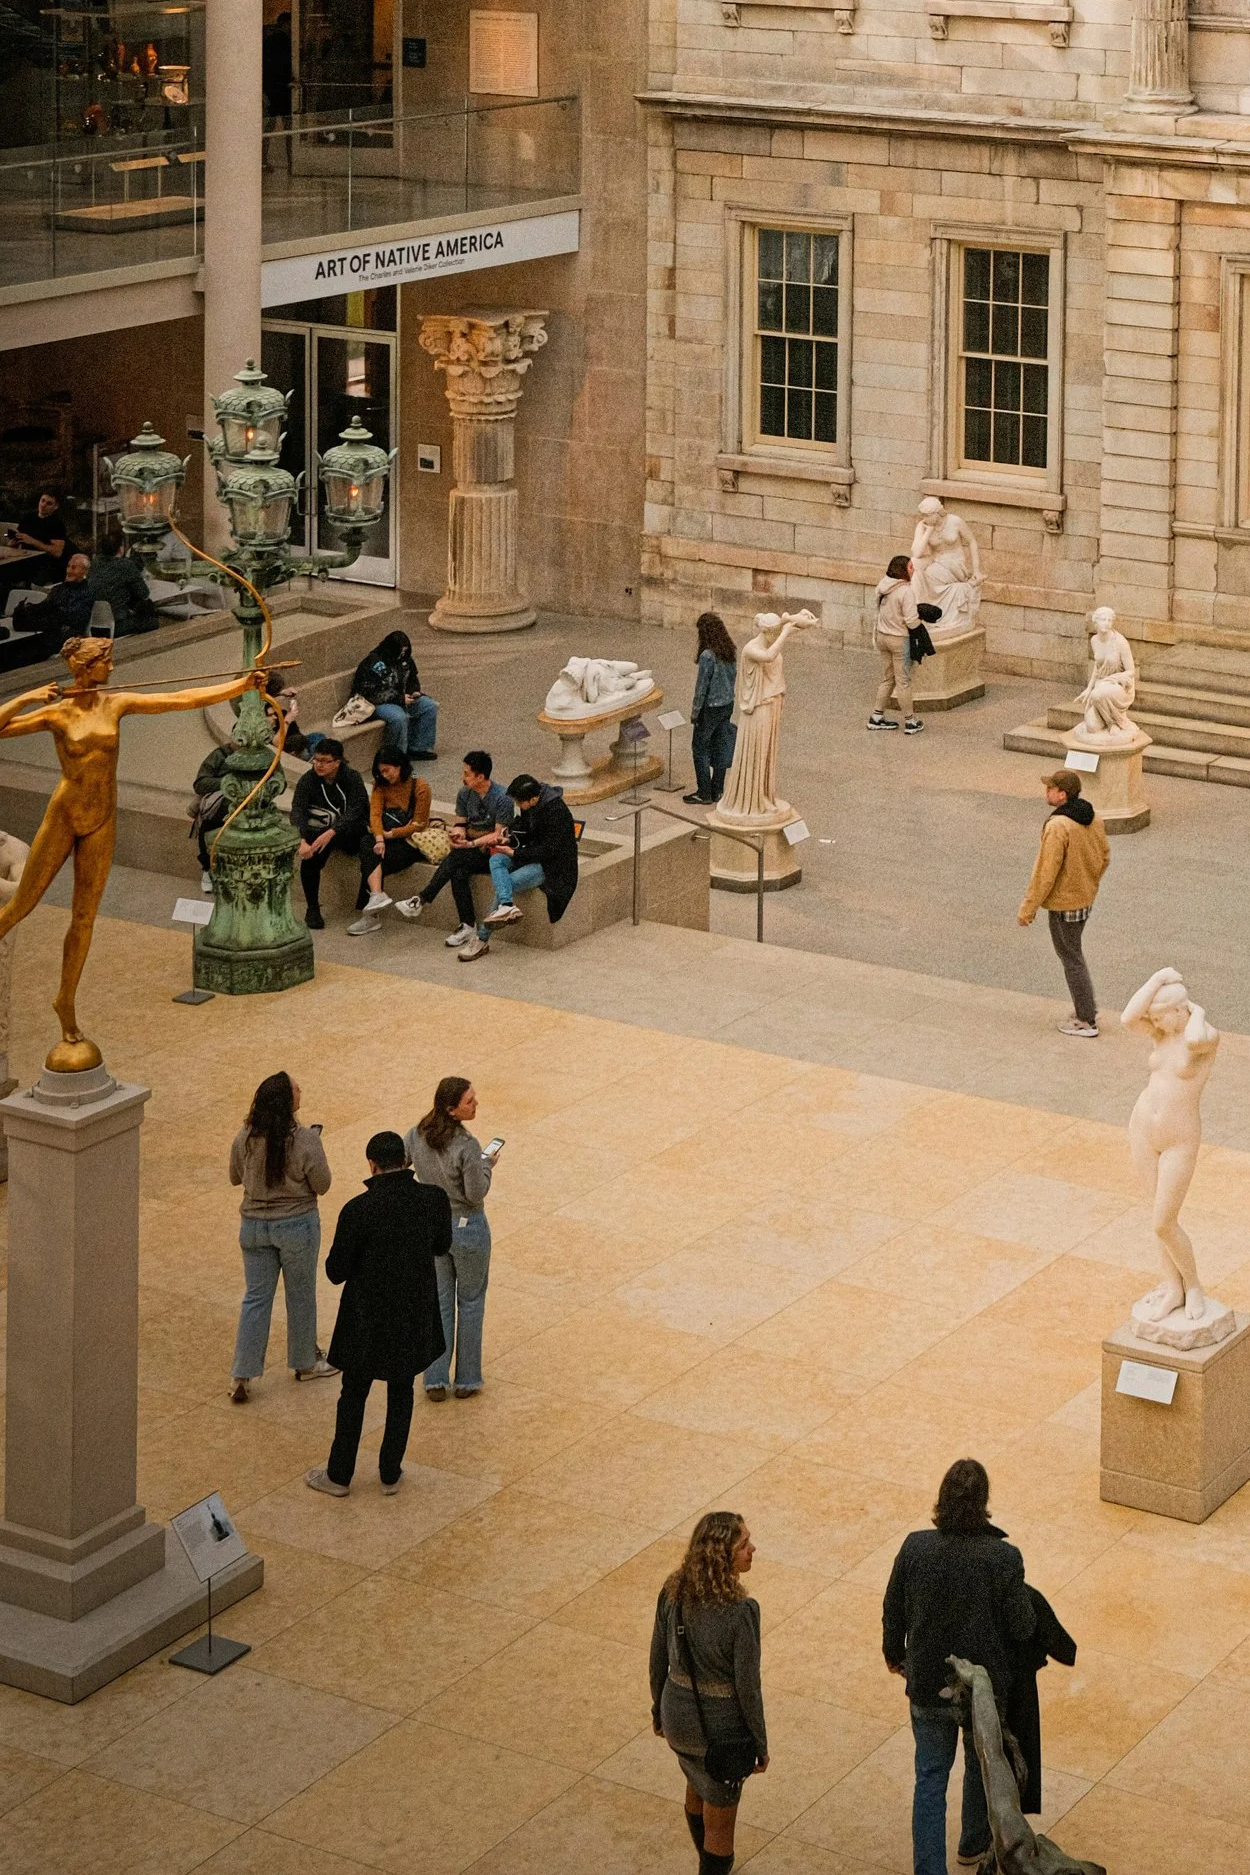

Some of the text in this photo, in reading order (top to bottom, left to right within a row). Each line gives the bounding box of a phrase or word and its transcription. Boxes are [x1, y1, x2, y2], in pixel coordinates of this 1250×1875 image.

[315, 231, 504, 280] ART OF NATIVE AMERICA
[359, 274, 369, 282] The
[393, 268, 403, 277] and
